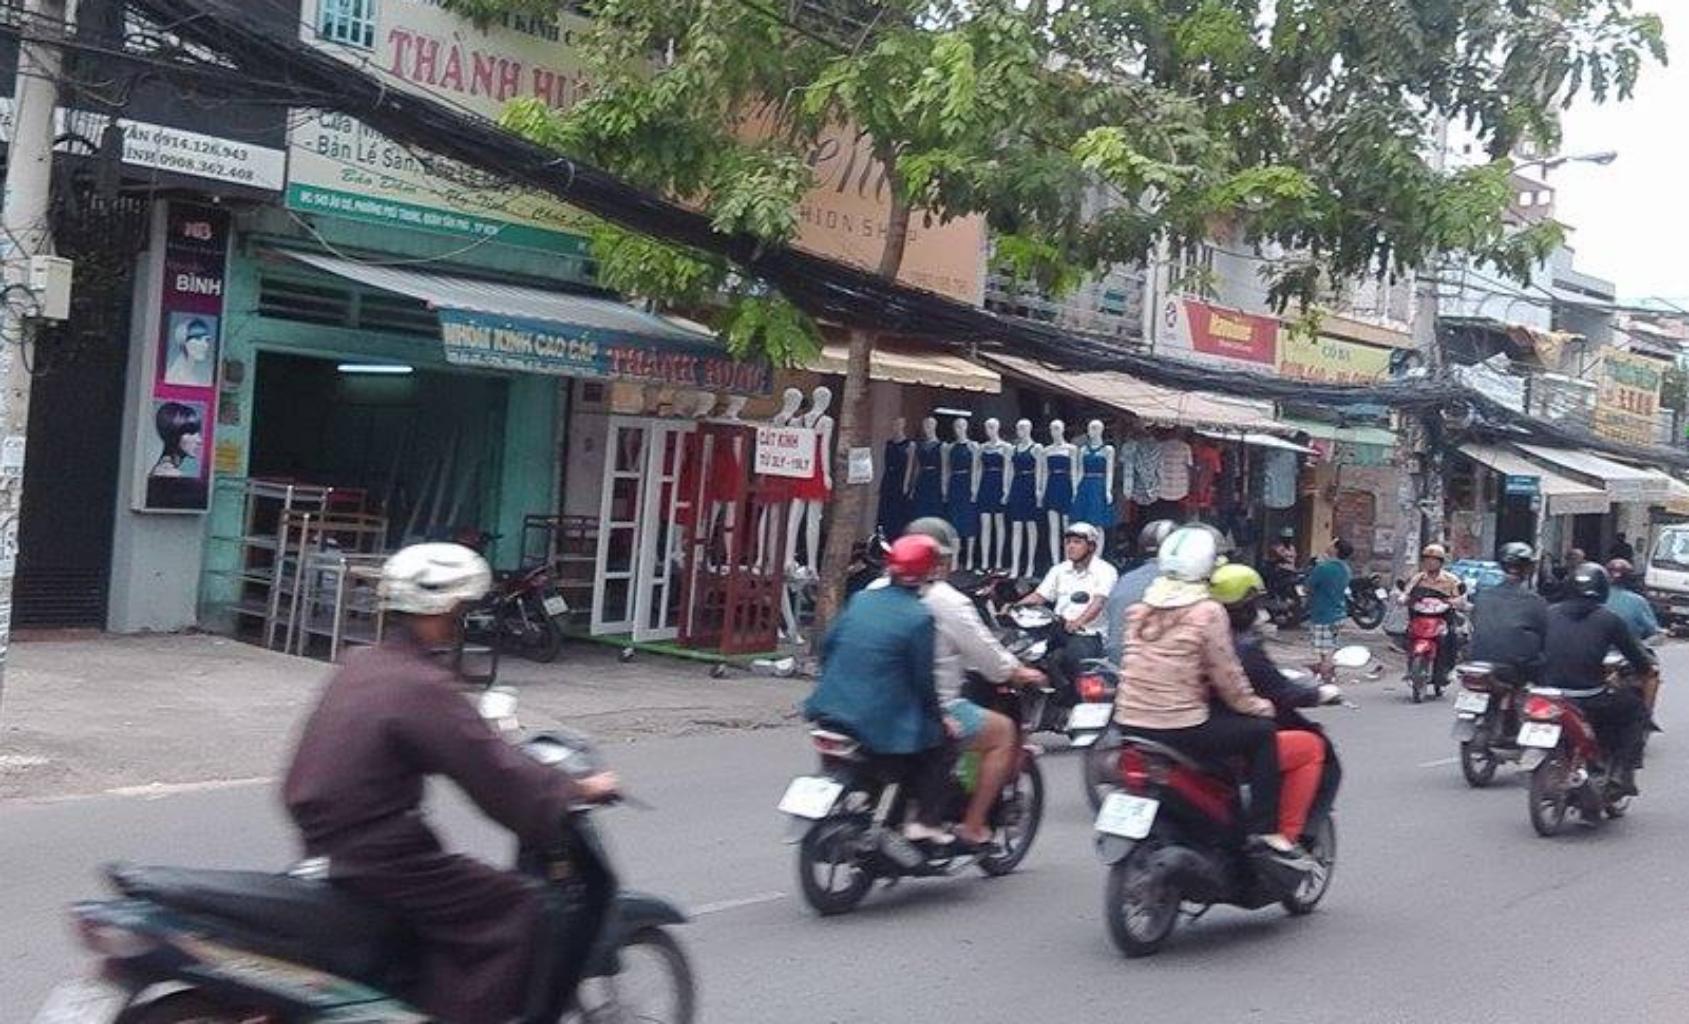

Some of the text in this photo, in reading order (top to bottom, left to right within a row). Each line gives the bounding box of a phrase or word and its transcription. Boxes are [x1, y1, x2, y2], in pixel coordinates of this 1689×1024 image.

[388, 28, 521, 102] THÀNH
[176, 271, 222, 297] BÌNH
[535, 332, 567, 358] CAO
